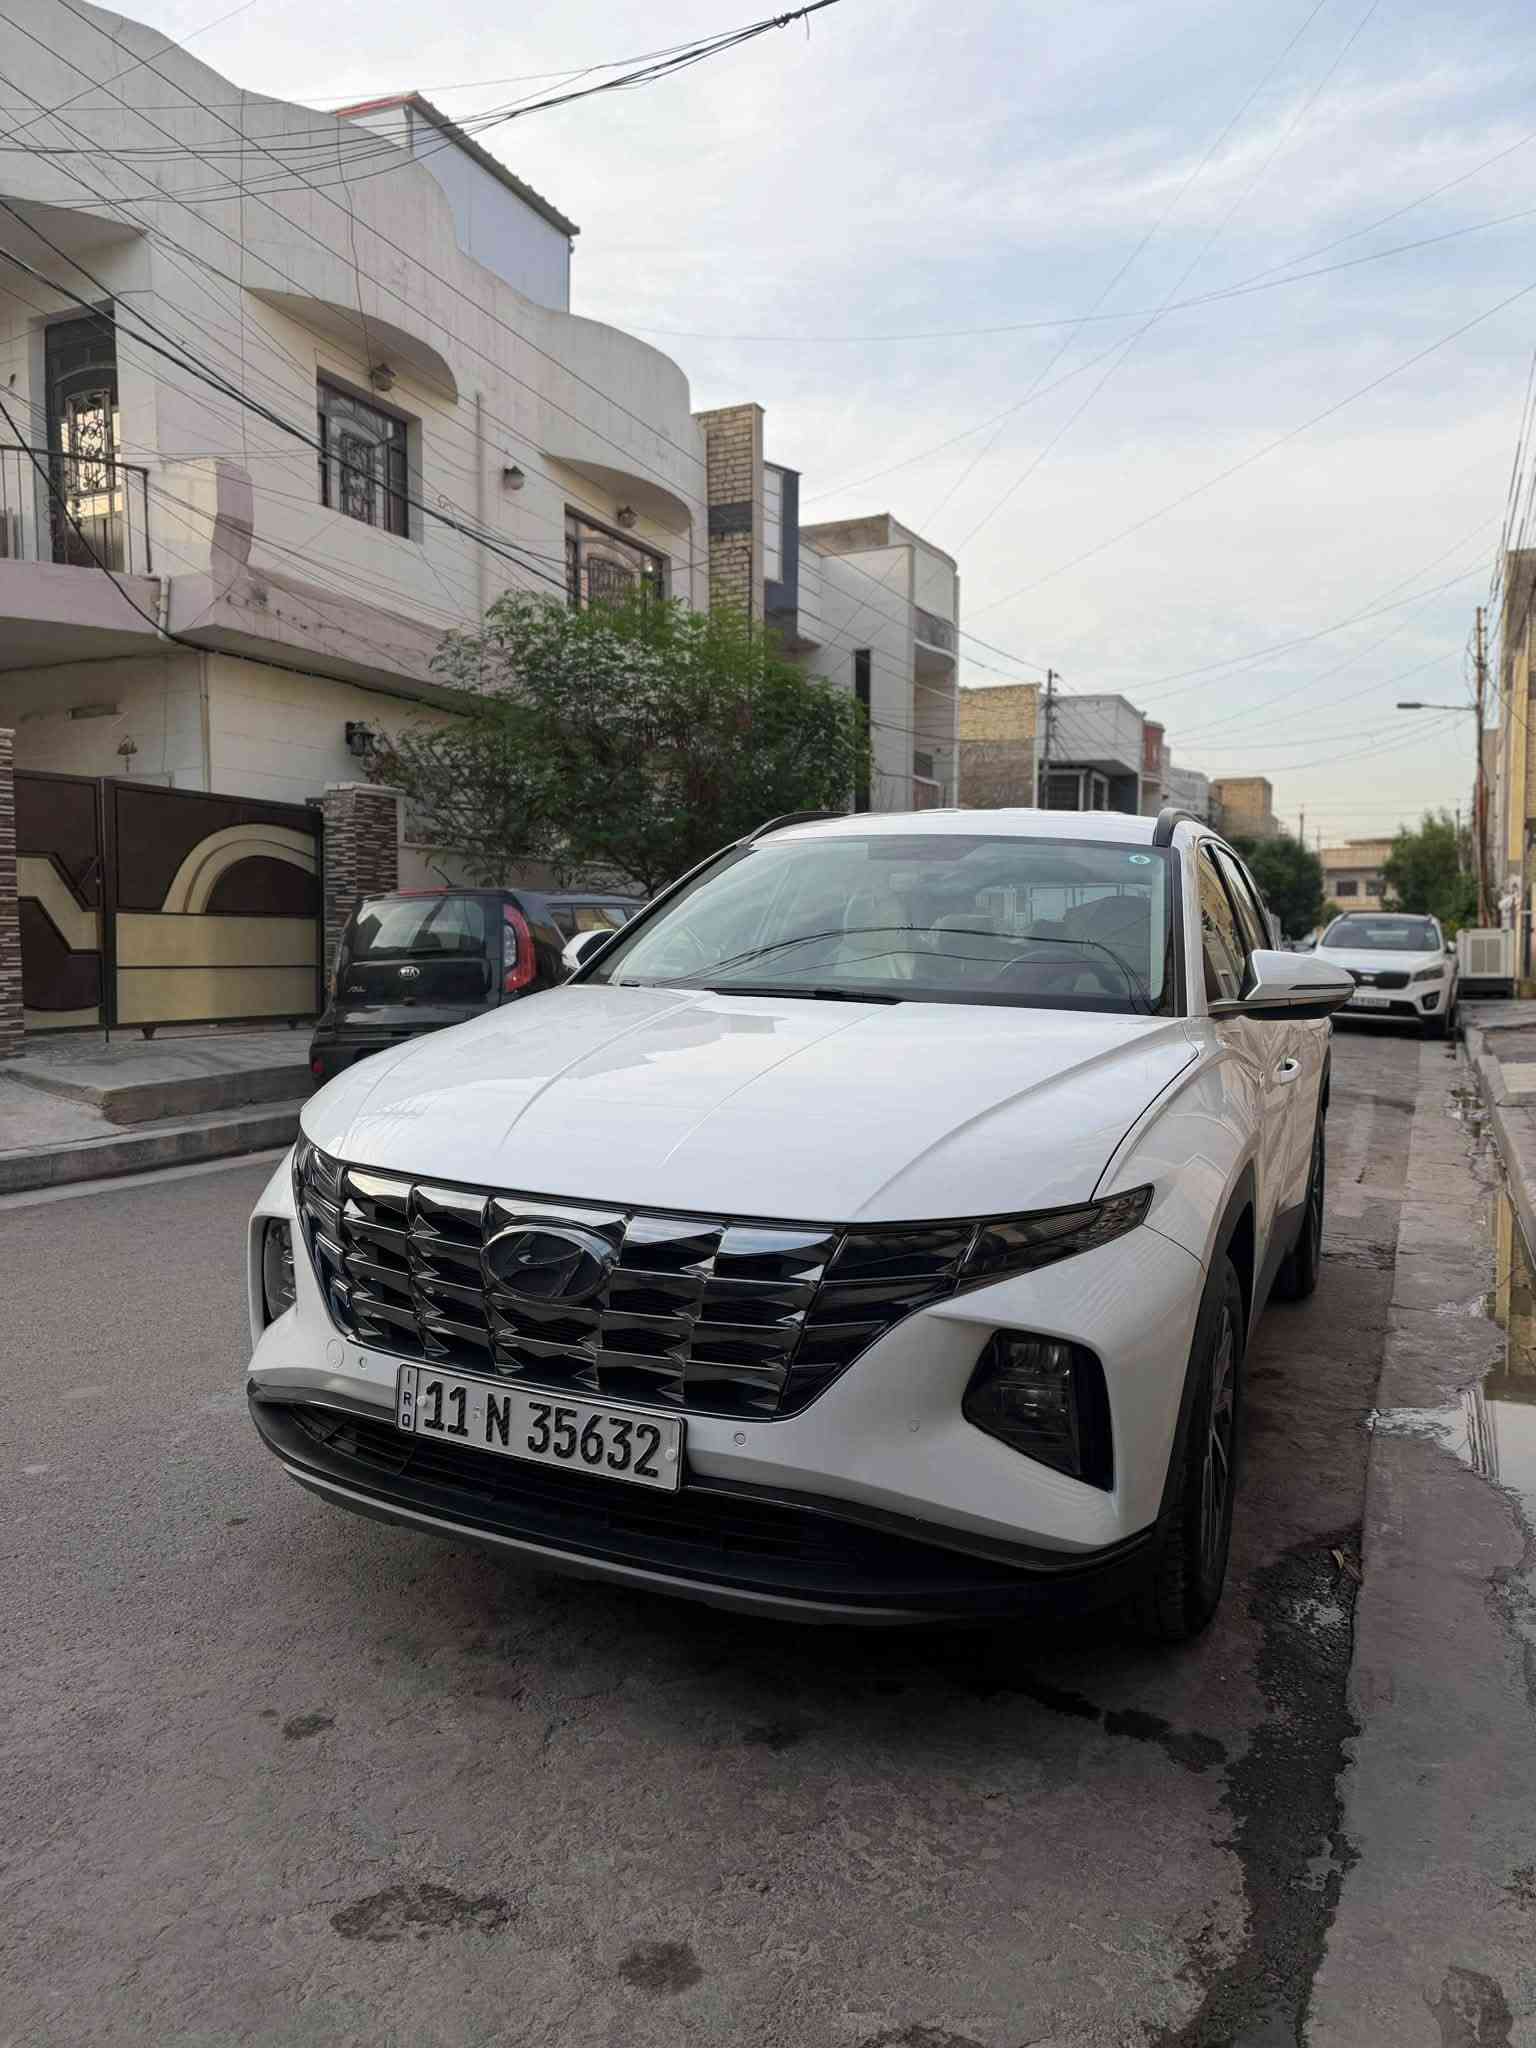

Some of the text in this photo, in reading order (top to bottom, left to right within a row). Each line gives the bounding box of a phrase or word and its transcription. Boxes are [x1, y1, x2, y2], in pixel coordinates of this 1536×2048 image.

[402, 1370, 412, 1427] IRQ
[424, 1380, 661, 1478] 11 N 35632
